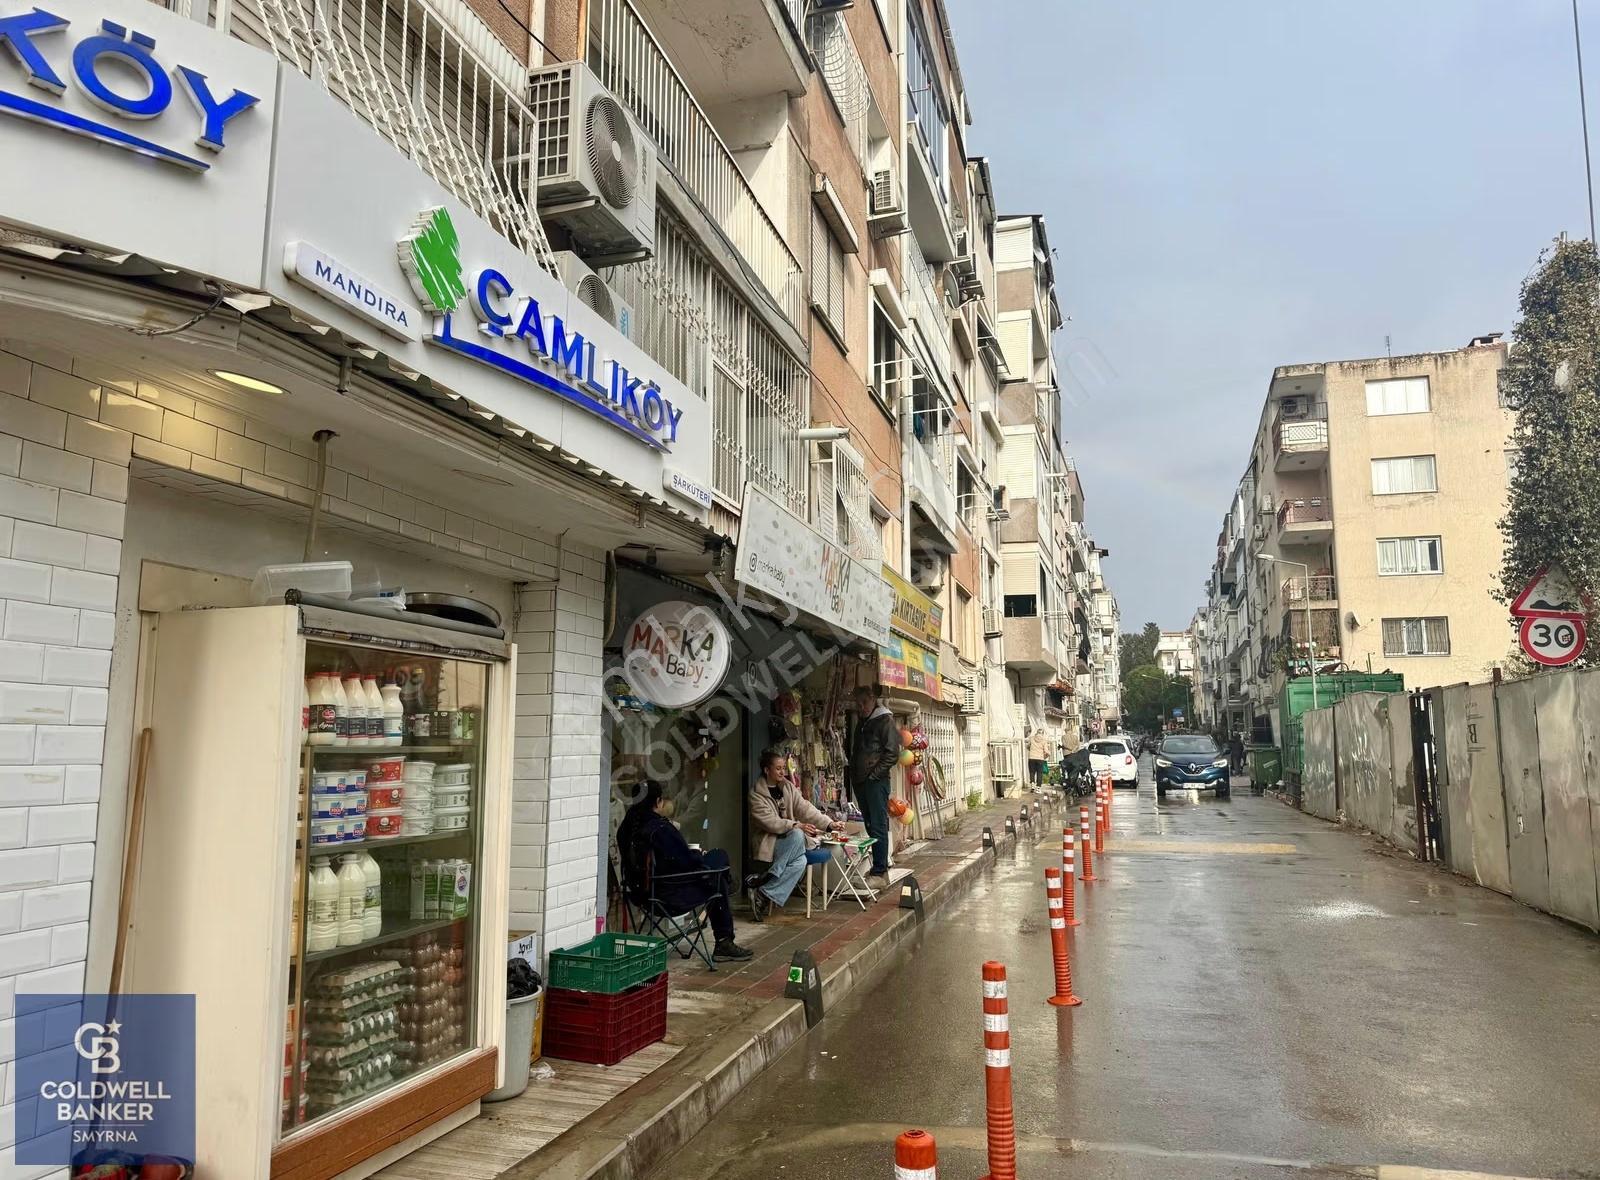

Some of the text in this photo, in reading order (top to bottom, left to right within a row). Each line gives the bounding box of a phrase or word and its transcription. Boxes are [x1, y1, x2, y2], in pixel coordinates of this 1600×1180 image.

[315, 260, 409, 328] MANDIRA
[474, 268, 684, 443] ÇAMLIKÖY
[819, 543, 852, 598] MARKA
[631, 623, 714, 665] MARKA
[1532, 624, 1575, 648] 30
[666, 653, 704, 684] Baby
